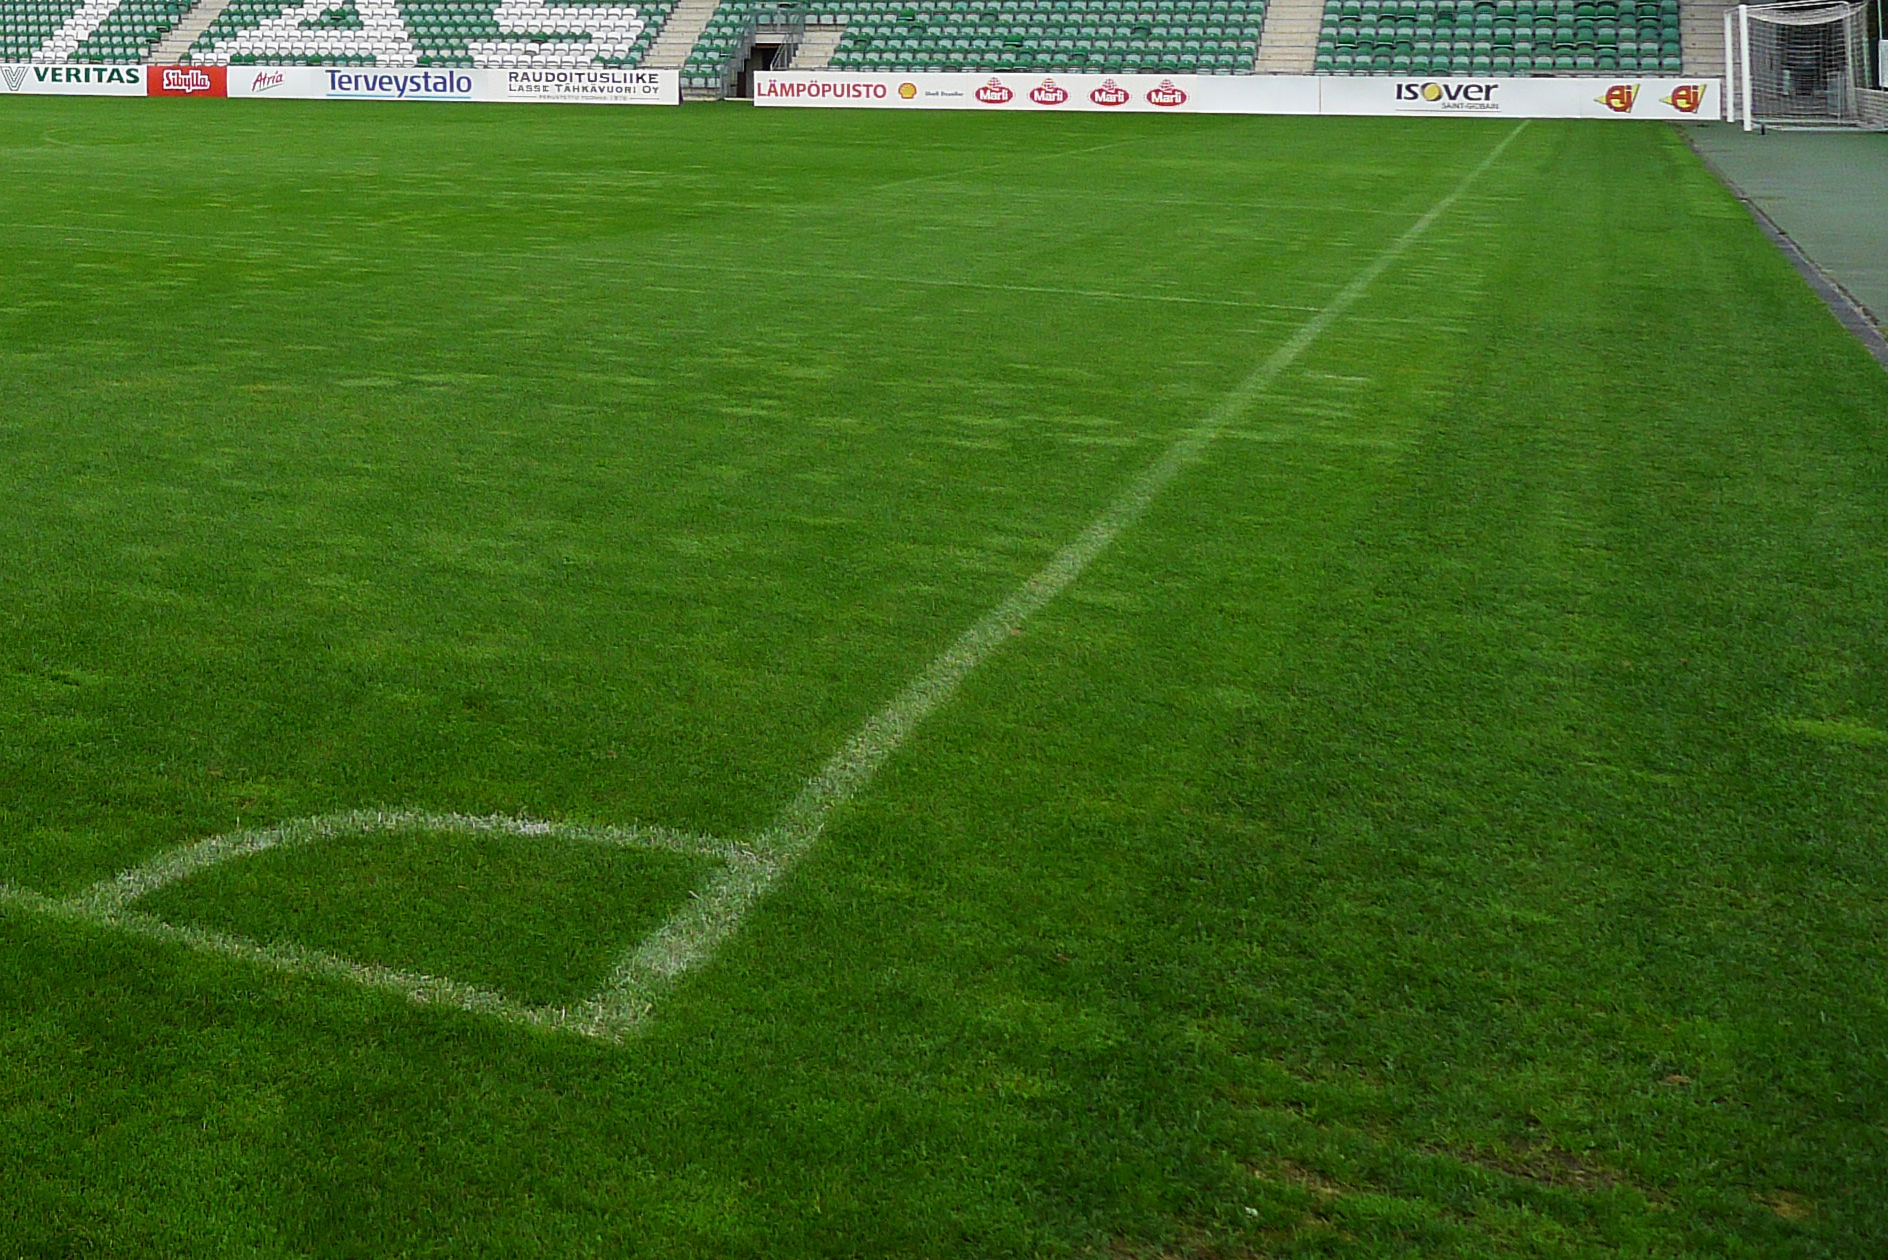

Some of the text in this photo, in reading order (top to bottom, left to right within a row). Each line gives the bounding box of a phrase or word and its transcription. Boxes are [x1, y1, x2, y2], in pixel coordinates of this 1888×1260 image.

[34, 67, 140, 84] VERITAS
[163, 71, 209, 91] Sibylla
[251, 71, 285, 90] Atria
[508, 72, 659, 84] RAUDOITUSLIIKE
[325, 70, 472, 97] Terveystalo
[757, 79, 887, 99] LÄMPÖPUISTO
[979, 89, 1008, 101] Marli
[1033, 91, 1063, 102] Marli
[1094, 92, 1124, 103] Marli
[1151, 92, 1182, 103] Marli
